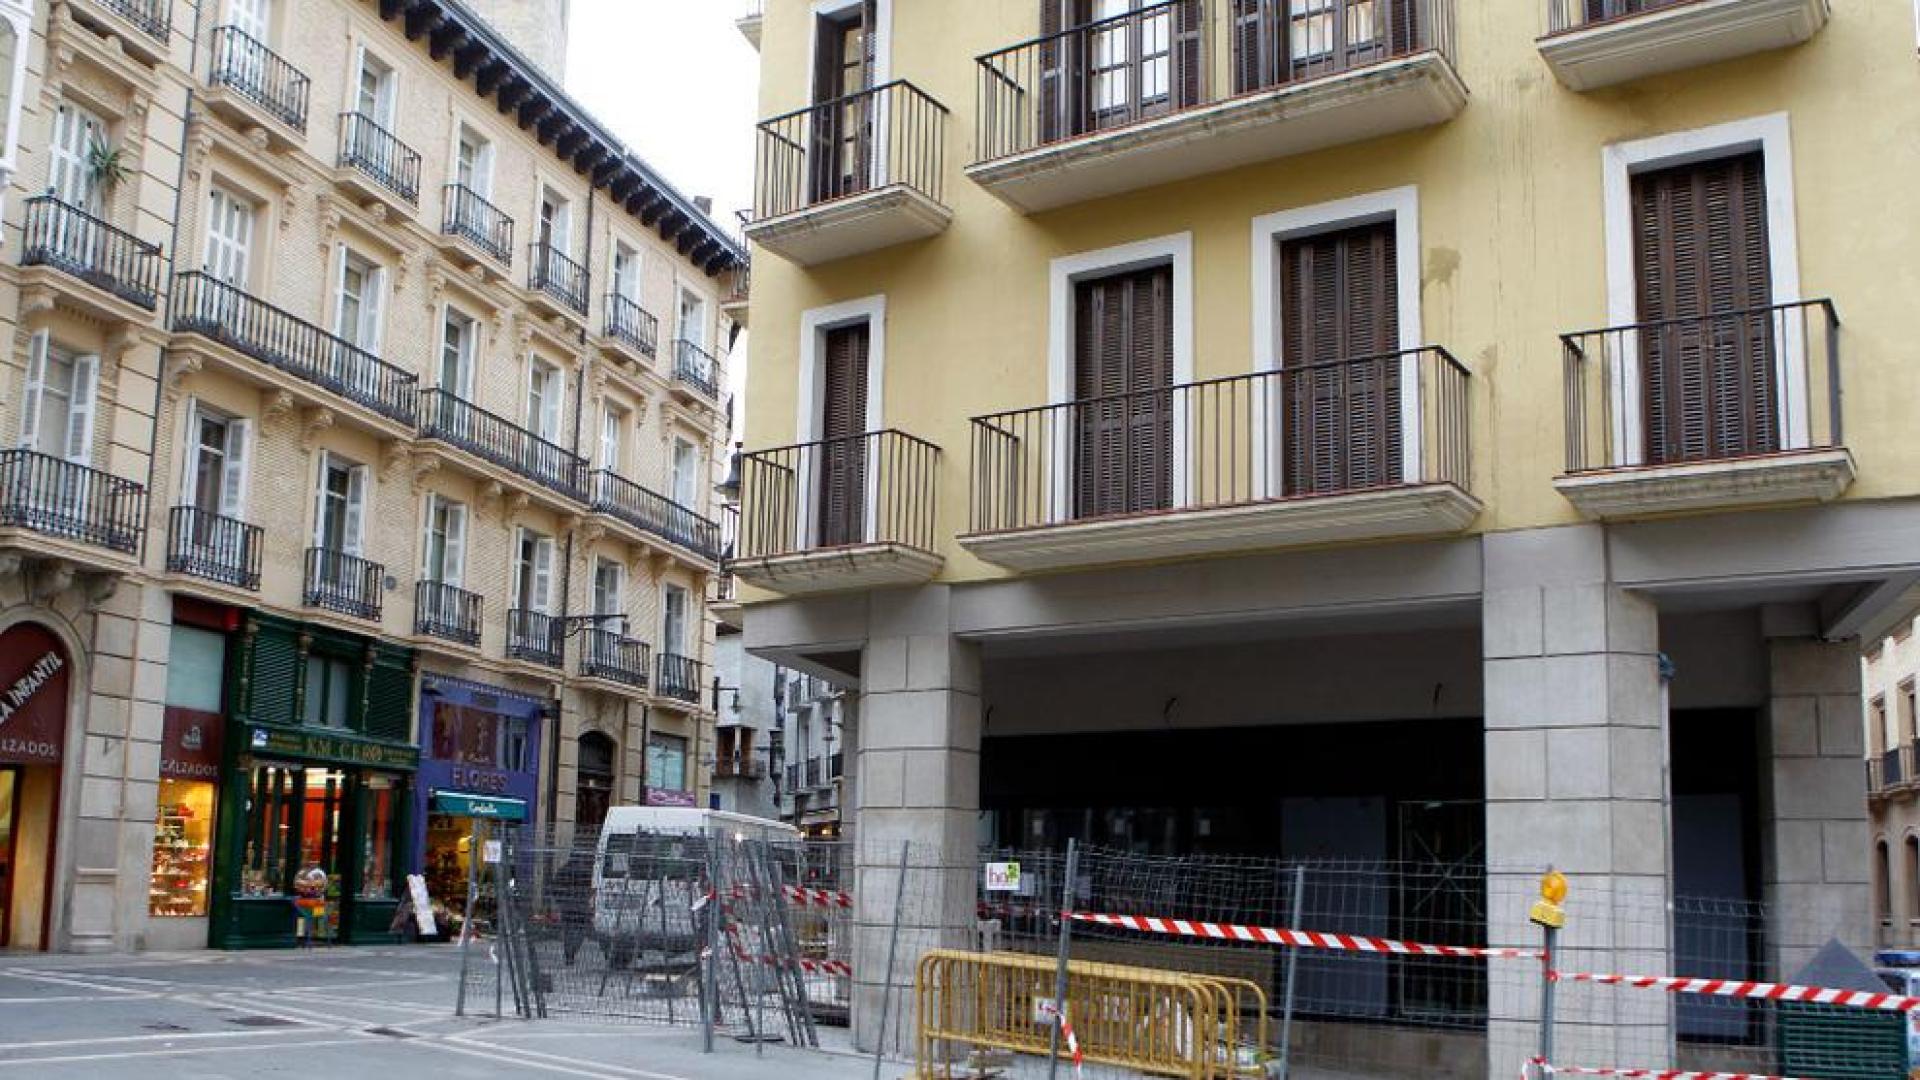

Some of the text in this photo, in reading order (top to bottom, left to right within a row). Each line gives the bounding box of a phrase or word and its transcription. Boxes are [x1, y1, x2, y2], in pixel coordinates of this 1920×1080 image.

[7, 651, 63, 707] INFANTIL
[160, 760, 218, 776] CALZADOS
[452, 766, 508, 791] FLORES
